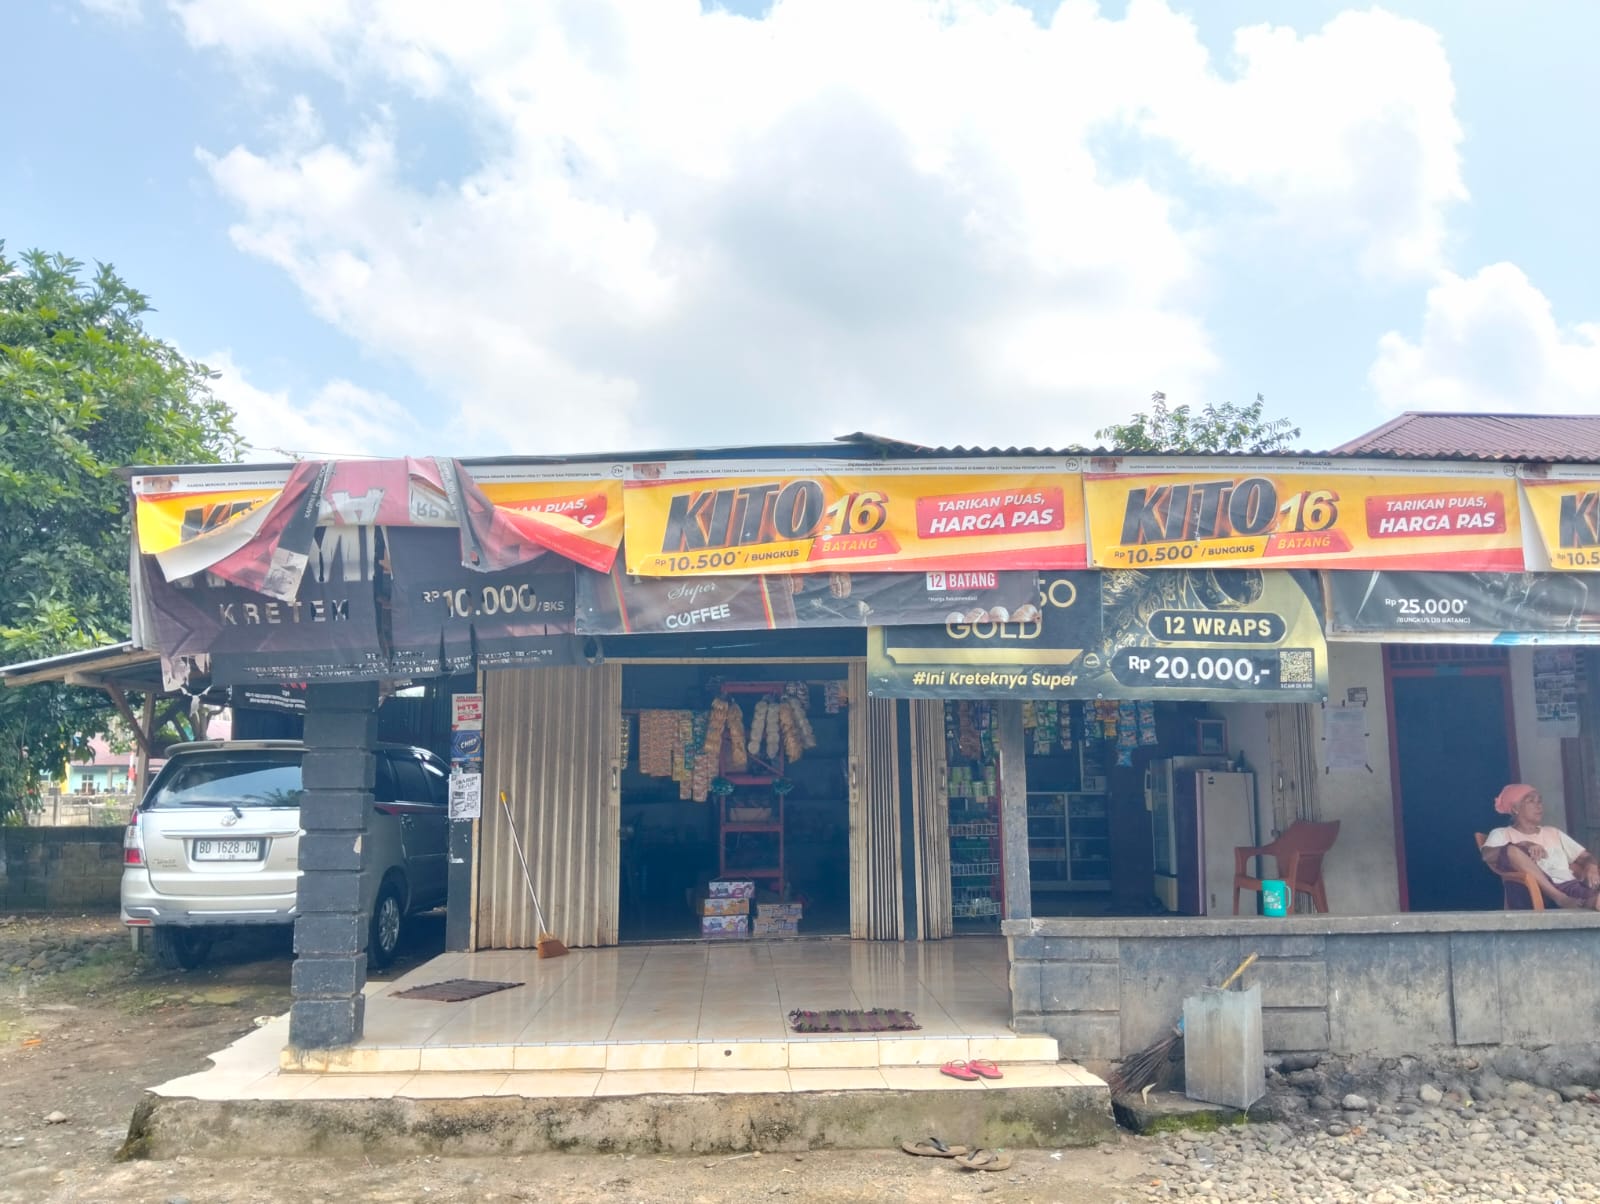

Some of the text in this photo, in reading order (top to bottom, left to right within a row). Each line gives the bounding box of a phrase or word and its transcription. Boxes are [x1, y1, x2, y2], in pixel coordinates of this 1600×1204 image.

[938, 493, 1045, 512] TARIKAN PUAS,
[1120, 478, 1340, 546] KITO 16
[1386, 497, 1488, 512] TARIKAN PUAS,
[662, 480, 825, 553] KITO
[827, 491, 889, 536] 16
[930, 509, 1054, 534] HARGA PAS
[1379, 512, 1496, 533] HARGA PAS
[822, 538, 878, 553] BATANG
[1114, 551, 1126, 560] Rp
[1208, 544, 1255, 556] BUNGKUS
[1278, 535, 1331, 550] BATANG
[655, 558, 667, 568] Rp
[751, 549, 800, 562] BUNGKUS
[928, 572, 996, 589] 12 BATANG
[422, 590, 440, 603] RP
[442, 584, 537, 618] 10.000
[1385, 599, 1397, 608] Rp
[219, 599, 349, 626] KRETEK
[666, 603, 732, 629] COFFEE
[1164, 616, 1272, 637] 12 WRAPS
[1128, 655, 1151, 674] Rp
[1155, 656, 1271, 685] 20.000,-
[912, 671, 1079, 691] #Ini Kreteknya Super
[199, 841, 211, 854] BD
